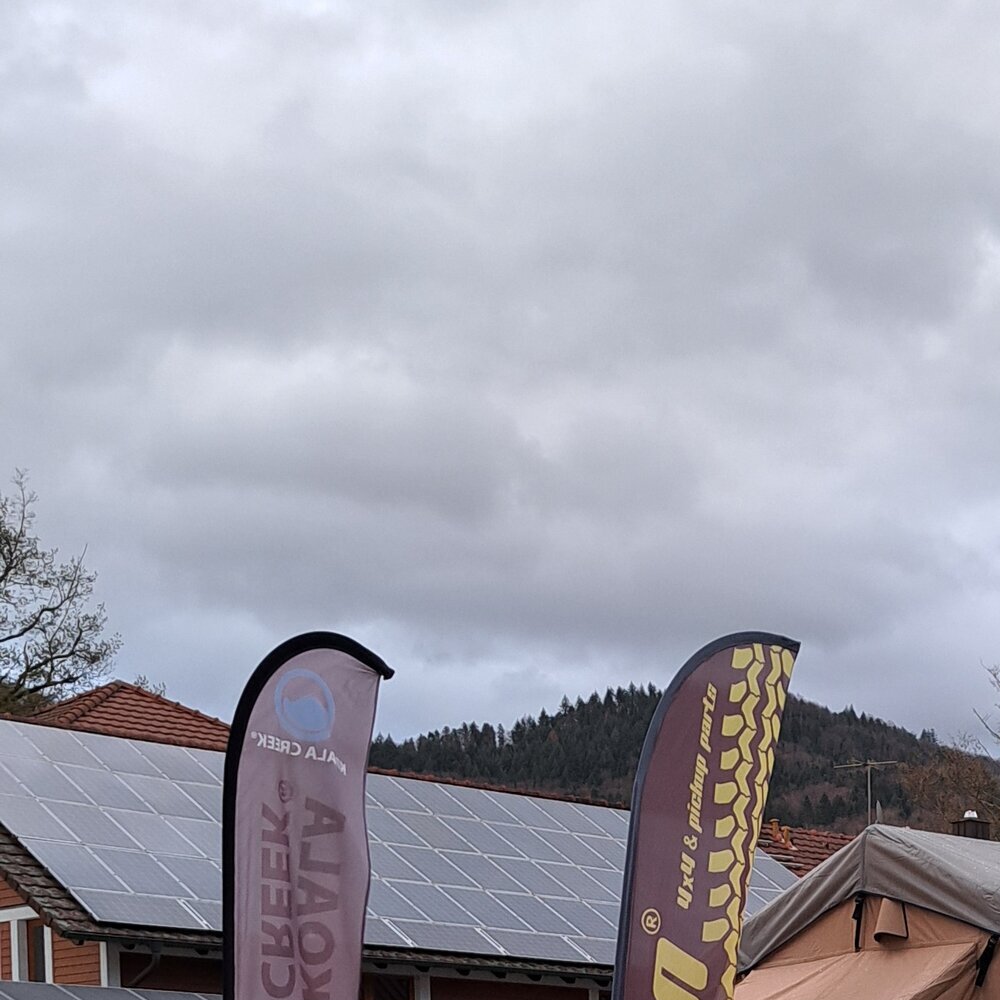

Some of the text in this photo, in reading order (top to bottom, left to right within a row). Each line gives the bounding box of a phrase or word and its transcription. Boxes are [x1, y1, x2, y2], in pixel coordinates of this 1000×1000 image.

[699, 682, 718, 753] parts
[687, 752, 710, 834] pickup
[683, 833, 699, 851] &
